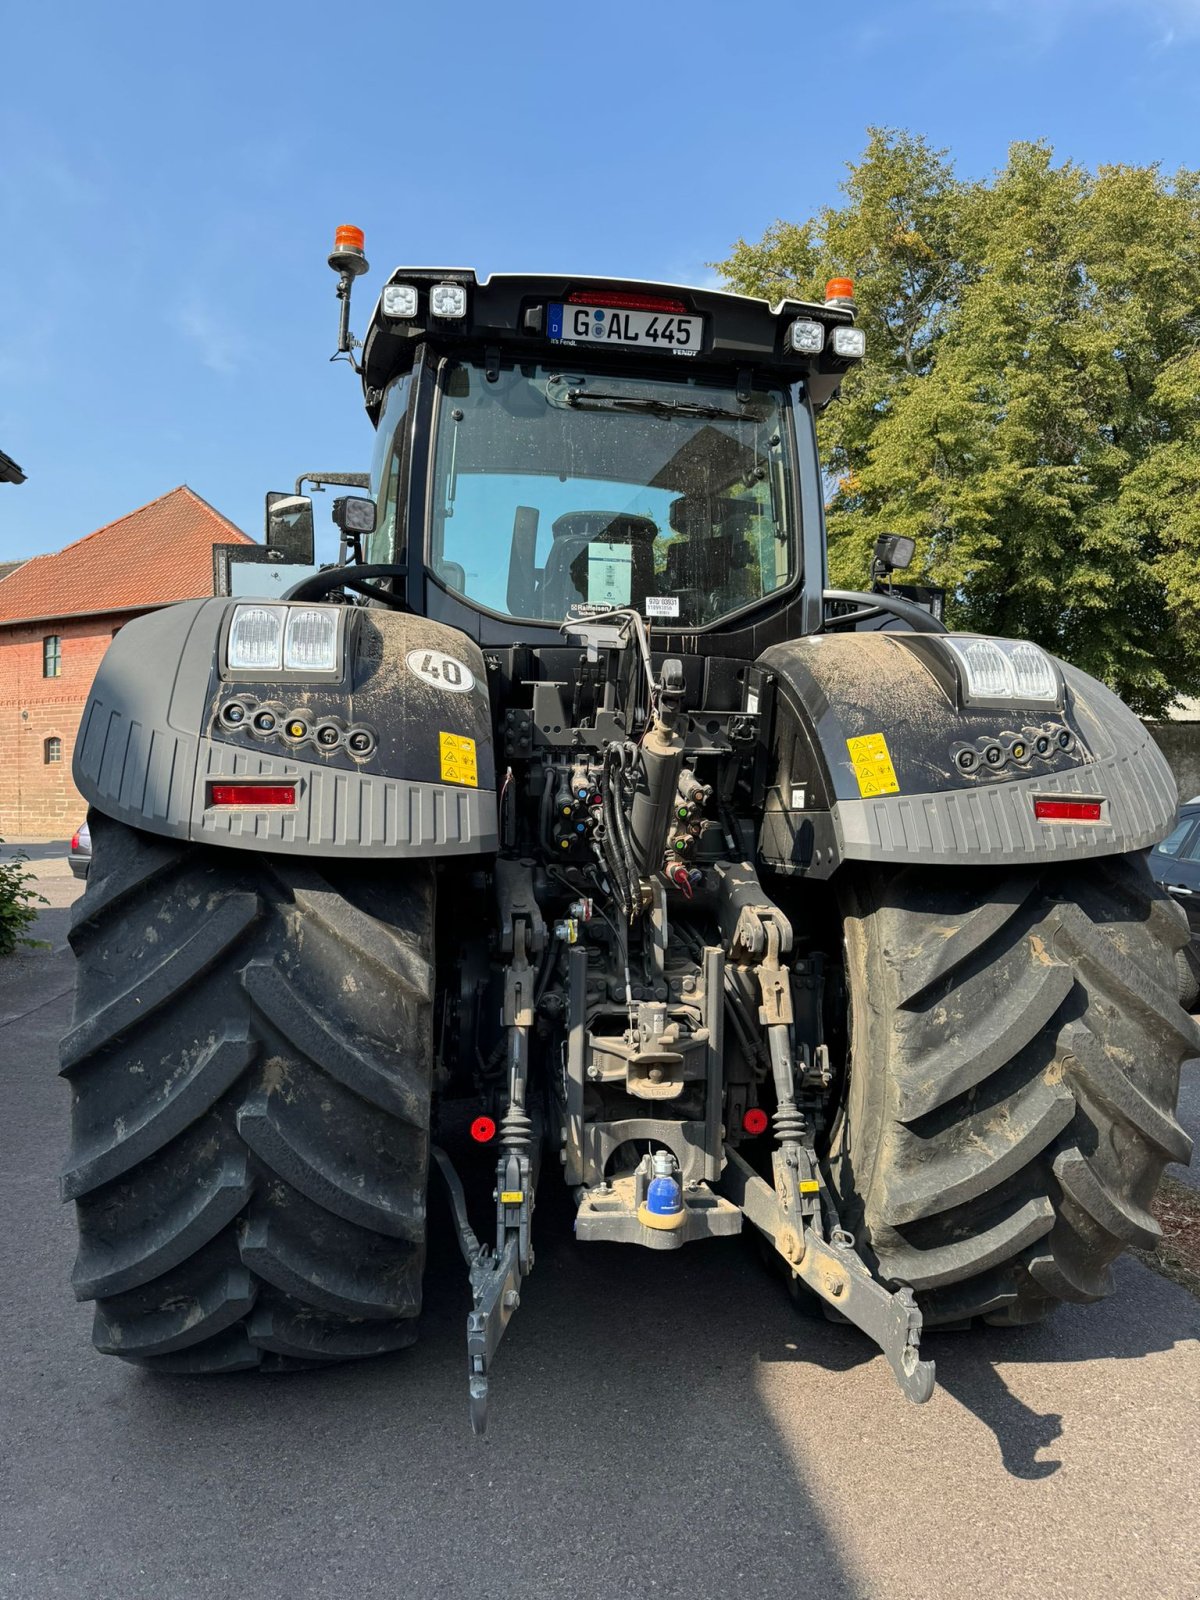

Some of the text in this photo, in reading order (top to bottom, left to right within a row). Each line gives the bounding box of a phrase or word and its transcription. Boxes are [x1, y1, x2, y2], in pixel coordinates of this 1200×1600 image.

[552, 324, 558, 332] D
[573, 309, 692, 345] G AL 445
[421, 654, 462, 685] 40
